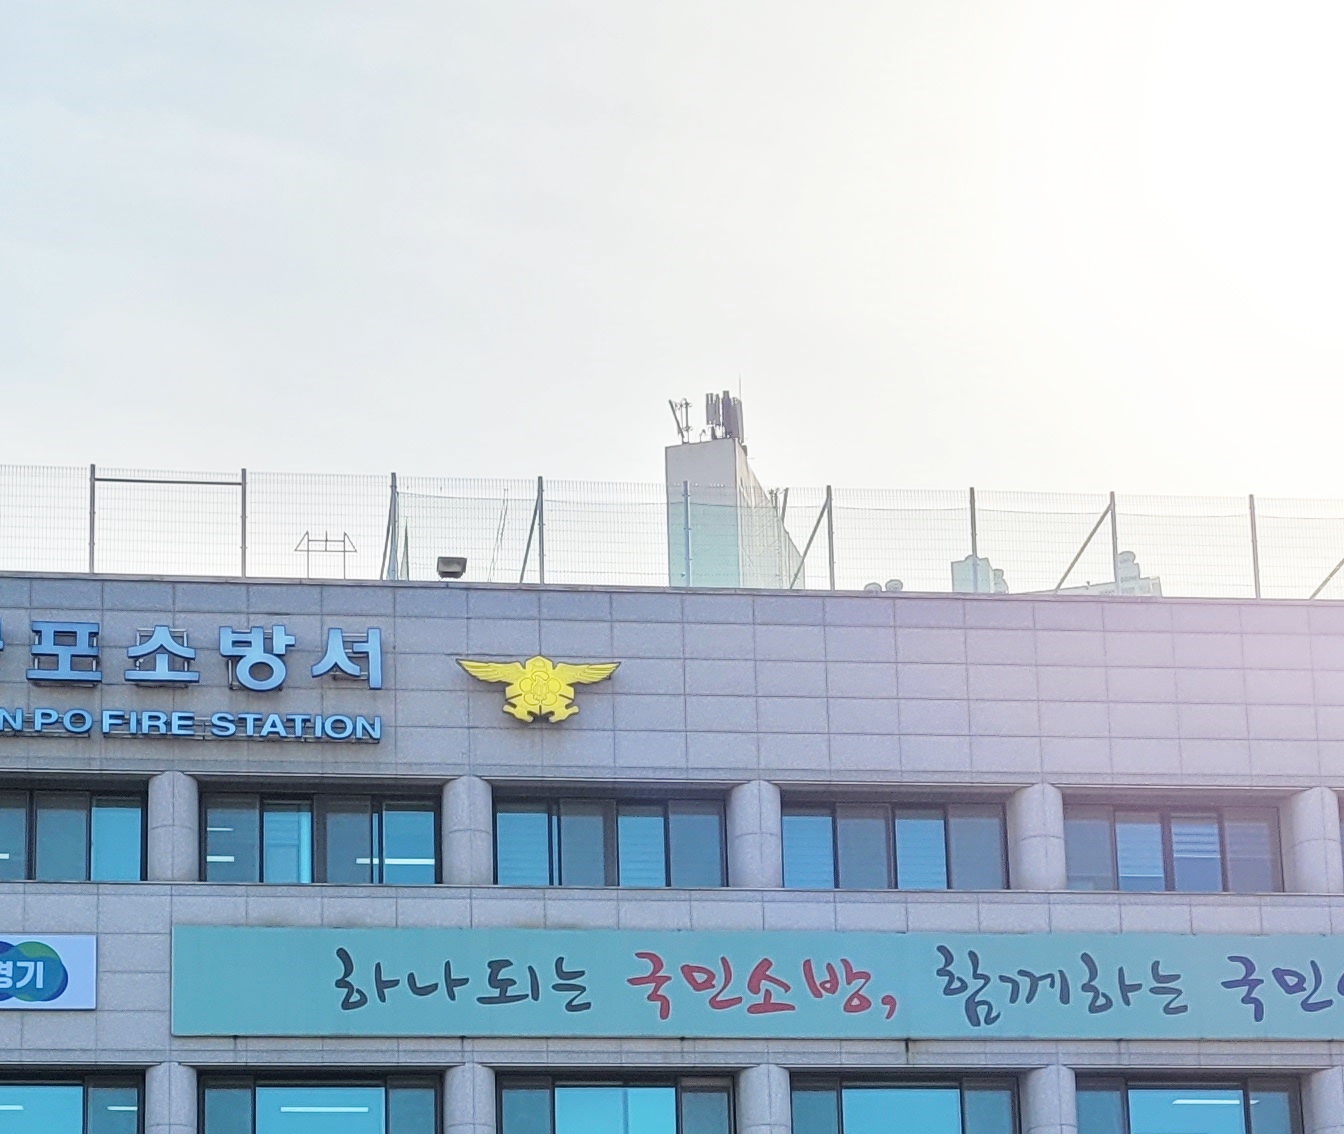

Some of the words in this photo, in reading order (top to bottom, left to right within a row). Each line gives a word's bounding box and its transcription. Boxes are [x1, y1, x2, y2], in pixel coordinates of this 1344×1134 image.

[102, 709, 195, 738] FIRE
[210, 711, 383, 742] STATION
[335, 947, 593, 1013] 하나되는
[626, 950, 898, 1021] 국민소방,
[934, 944, 1189, 1028] 함께하는
